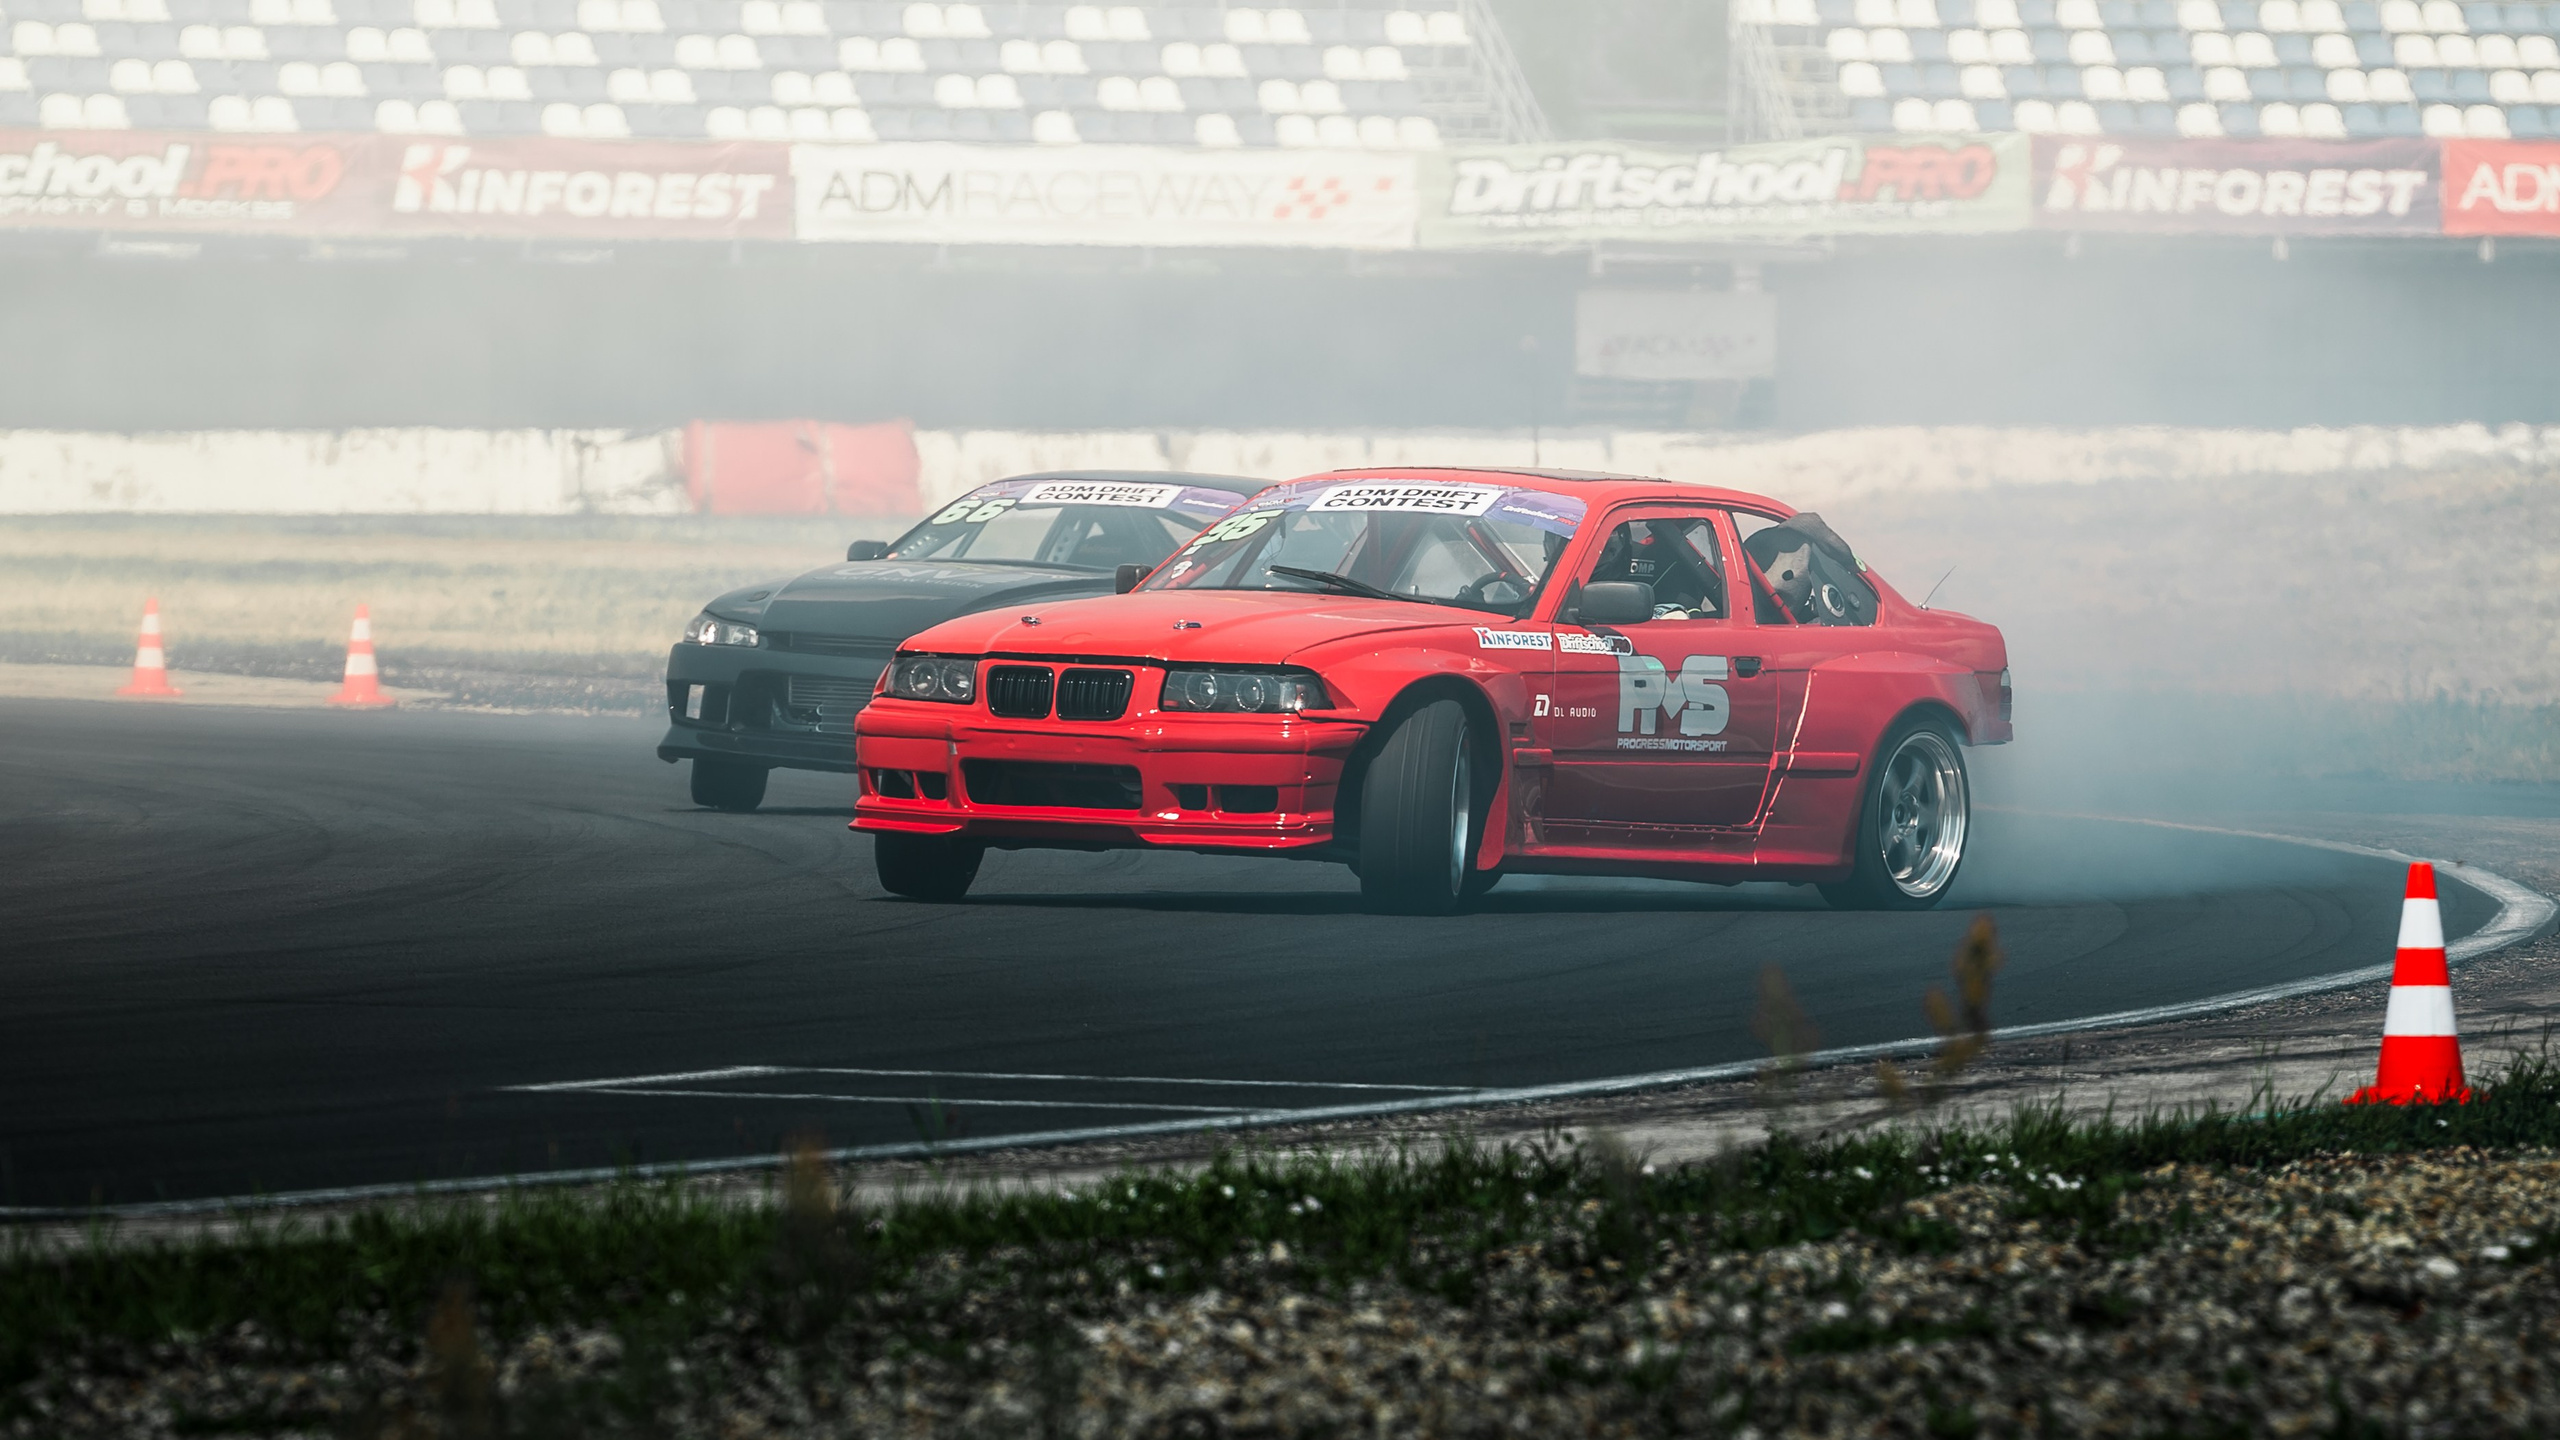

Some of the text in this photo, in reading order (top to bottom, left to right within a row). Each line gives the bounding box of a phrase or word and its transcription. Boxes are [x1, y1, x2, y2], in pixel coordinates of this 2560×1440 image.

[394, 143, 774, 218] KINFOREST
[2044, 143, 2427, 217] KINFOREST
[1042, 484, 1170, 496] ADM DRIFT
[1334, 488, 1489, 501] ADM DRIFT
[1032, 491, 1159, 504] CONTEST
[1324, 497, 1479, 511] CONTEST
[931, 499, 1018, 525] 66
[1630, 561, 1655, 574] OMP
[1478, 629, 1550, 648] KINFOREST
[1554, 707, 1597, 718] DL AUDIO
